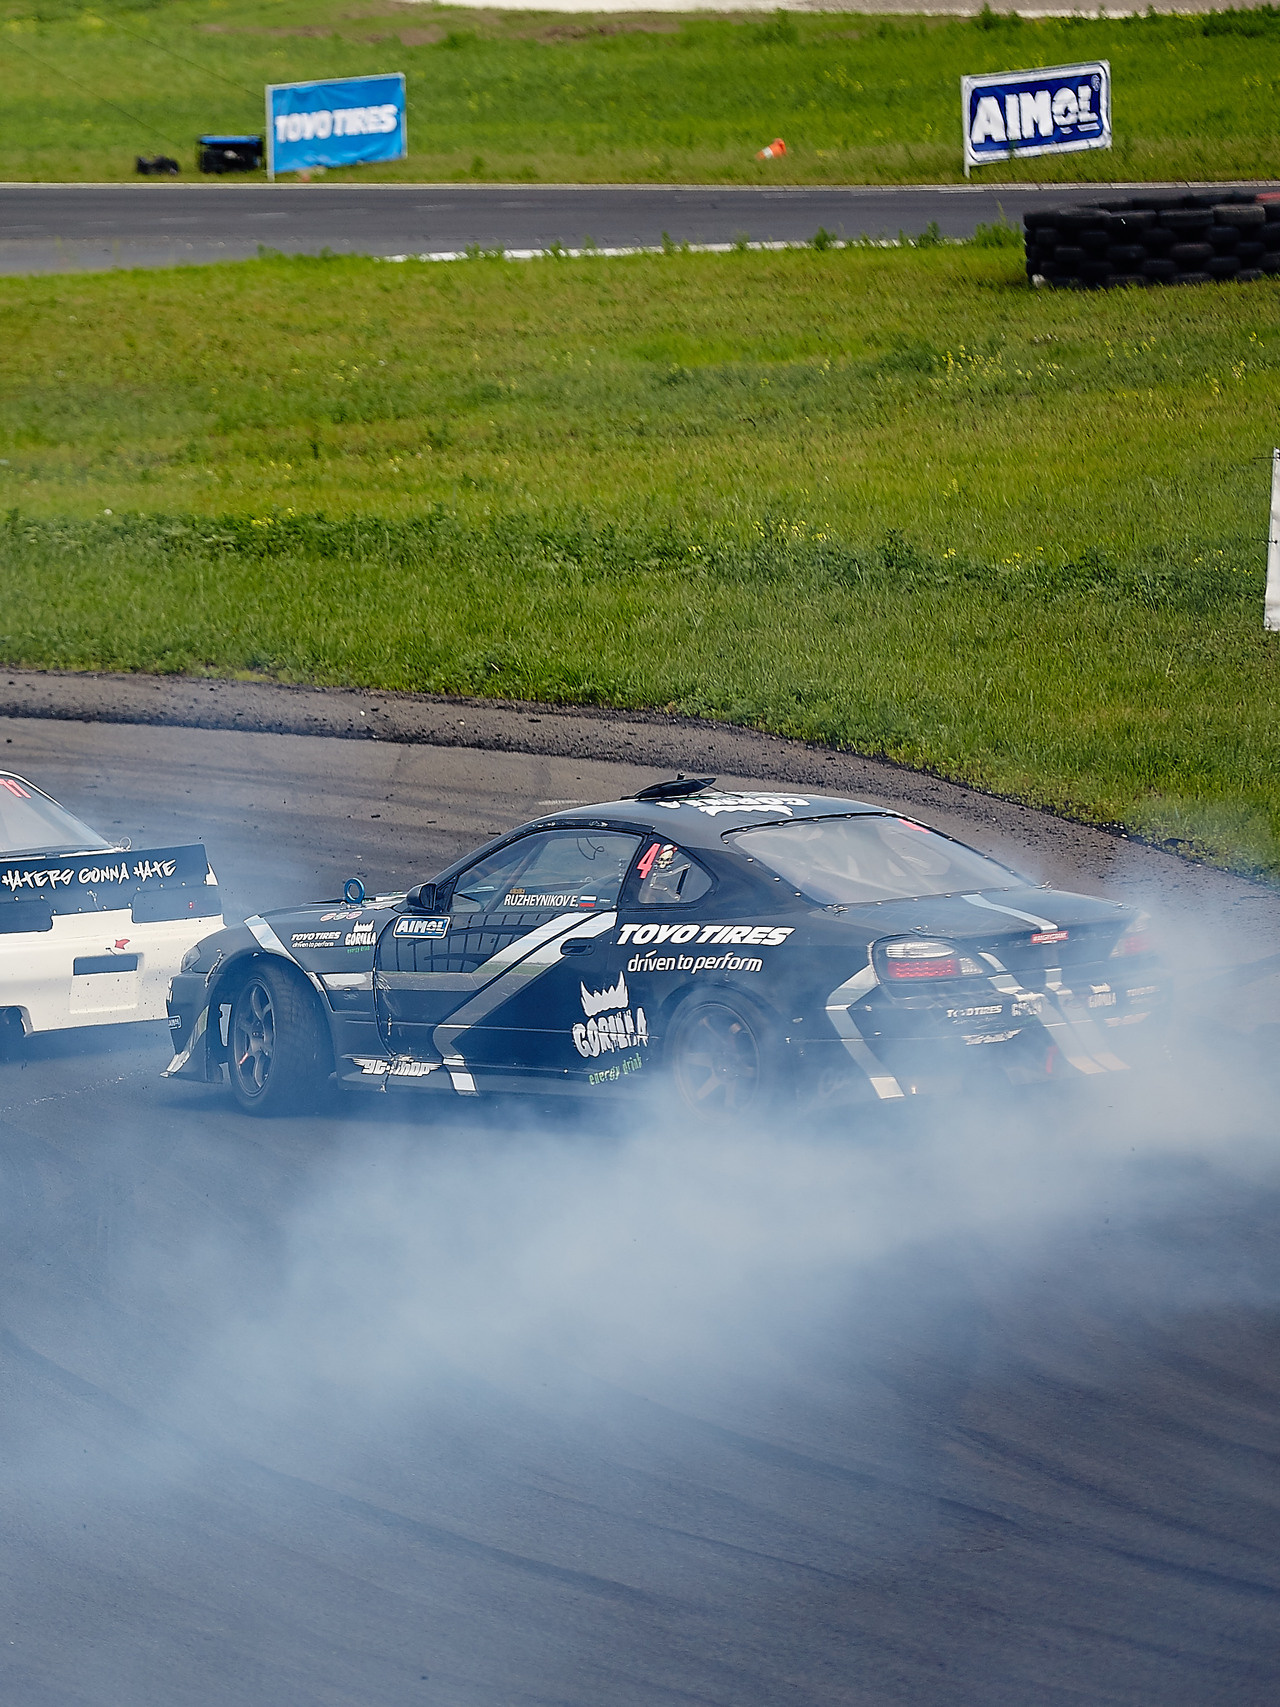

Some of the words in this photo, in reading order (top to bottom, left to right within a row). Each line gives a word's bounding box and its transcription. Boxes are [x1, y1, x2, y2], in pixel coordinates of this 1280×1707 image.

[275, 110, 333, 143] TOYO
[333, 104, 398, 137] TIRES
[971, 84, 1099, 144] AIMOL
[2, 868, 75, 892] HATERS
[78, 861, 130, 885] GONNA
[133, 858, 177, 882] HATE
[637, 843, 661, 879] 4
[503, 894, 571, 907] RUZHEYNIKOV
[291, 932, 316, 941] TOYO
[315, 931, 342, 940] TIRES
[396, 919, 445, 934] AIMOL
[617, 923, 703, 946] TOYO
[699, 923, 797, 947] TIRES
[627, 950, 679, 972] driven
[677, 954, 693, 971] to
[690, 952, 763, 974] perform
[946, 1006, 974, 1018] TO
[973, 1004, 1003, 1016] TIRES
[572, 1007, 649, 1058] GORILLA
[589, 1065, 621, 1086] energy
[622, 1053, 642, 1076] drink
